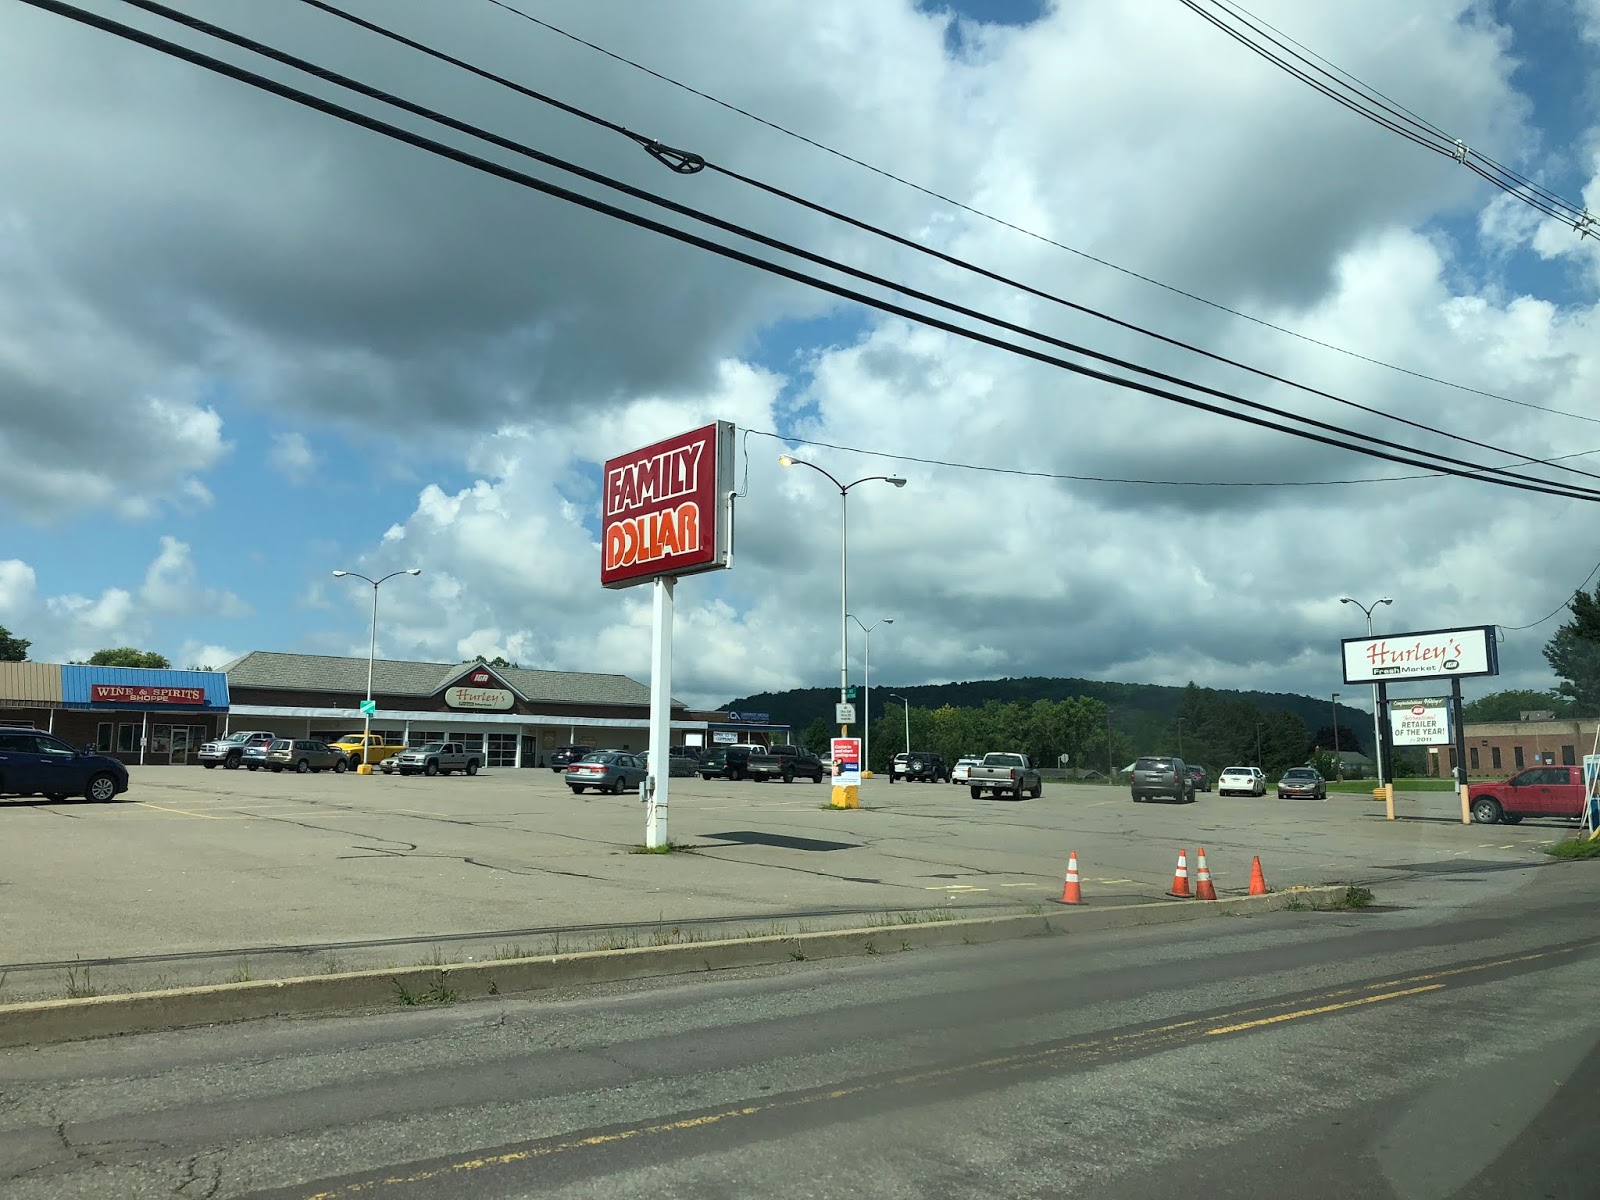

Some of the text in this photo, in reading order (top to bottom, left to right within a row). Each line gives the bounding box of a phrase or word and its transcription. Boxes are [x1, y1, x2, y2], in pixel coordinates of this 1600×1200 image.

[607, 440, 706, 516] FAMILY
[605, 501, 700, 571] DOLLAR
[1366, 638, 1462, 672] Hurley's
[1373, 665, 1437, 675] Fresh Market
[1445, 660, 1458, 669] IGA
[474, 674, 489, 682] IGA
[97, 686, 134, 697] WINE
[153, 688, 200, 700] SPIRITS
[130, 694, 169, 702] SHOPPE
[455, 688, 506, 708] Hurley's
[1401, 720, 1437, 728] RETAILER
